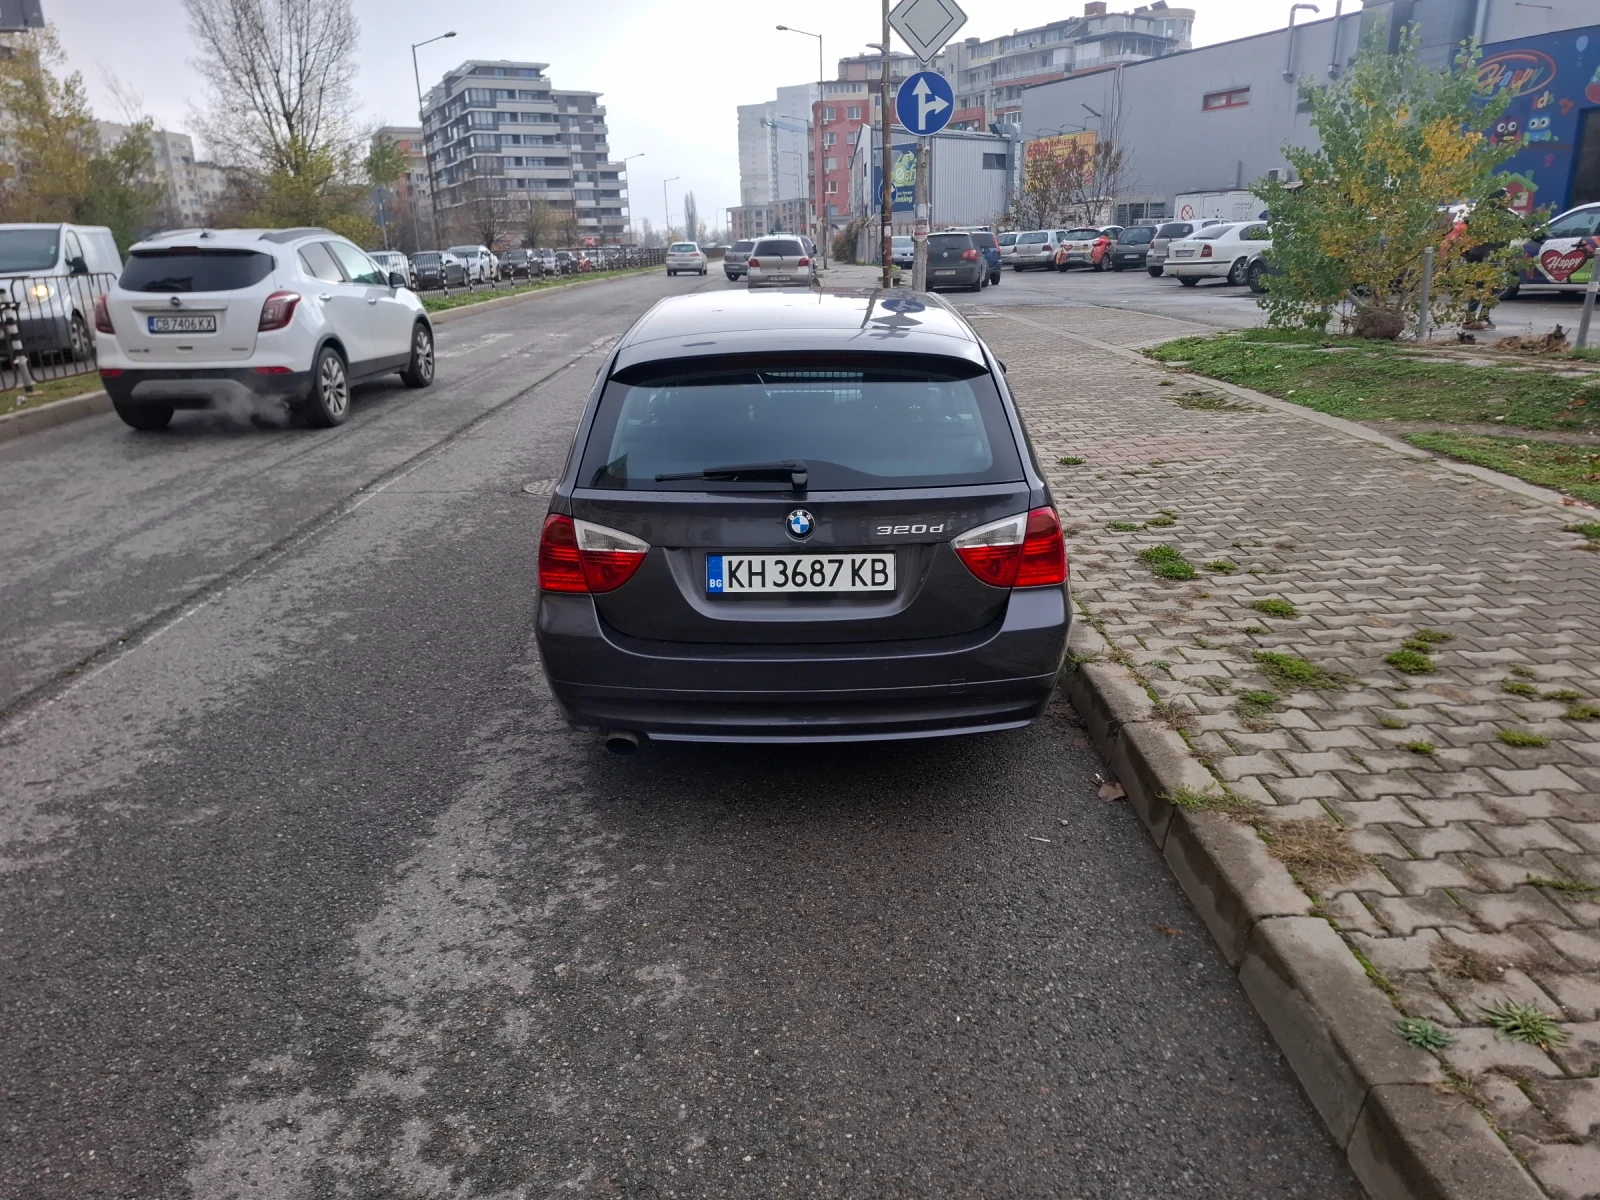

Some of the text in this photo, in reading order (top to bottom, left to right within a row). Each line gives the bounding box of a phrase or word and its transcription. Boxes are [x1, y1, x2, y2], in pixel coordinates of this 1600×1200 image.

[1477, 64, 1544, 93] Happy
[1546, 256, 1582, 269] Happy
[155, 318, 214, 331] CB 7406 KX
[787, 510, 812, 521] BMW
[876, 523, 945, 536] 320d
[727, 557, 889, 589] KH 3687 KB
[709, 579, 722, 588] BG
